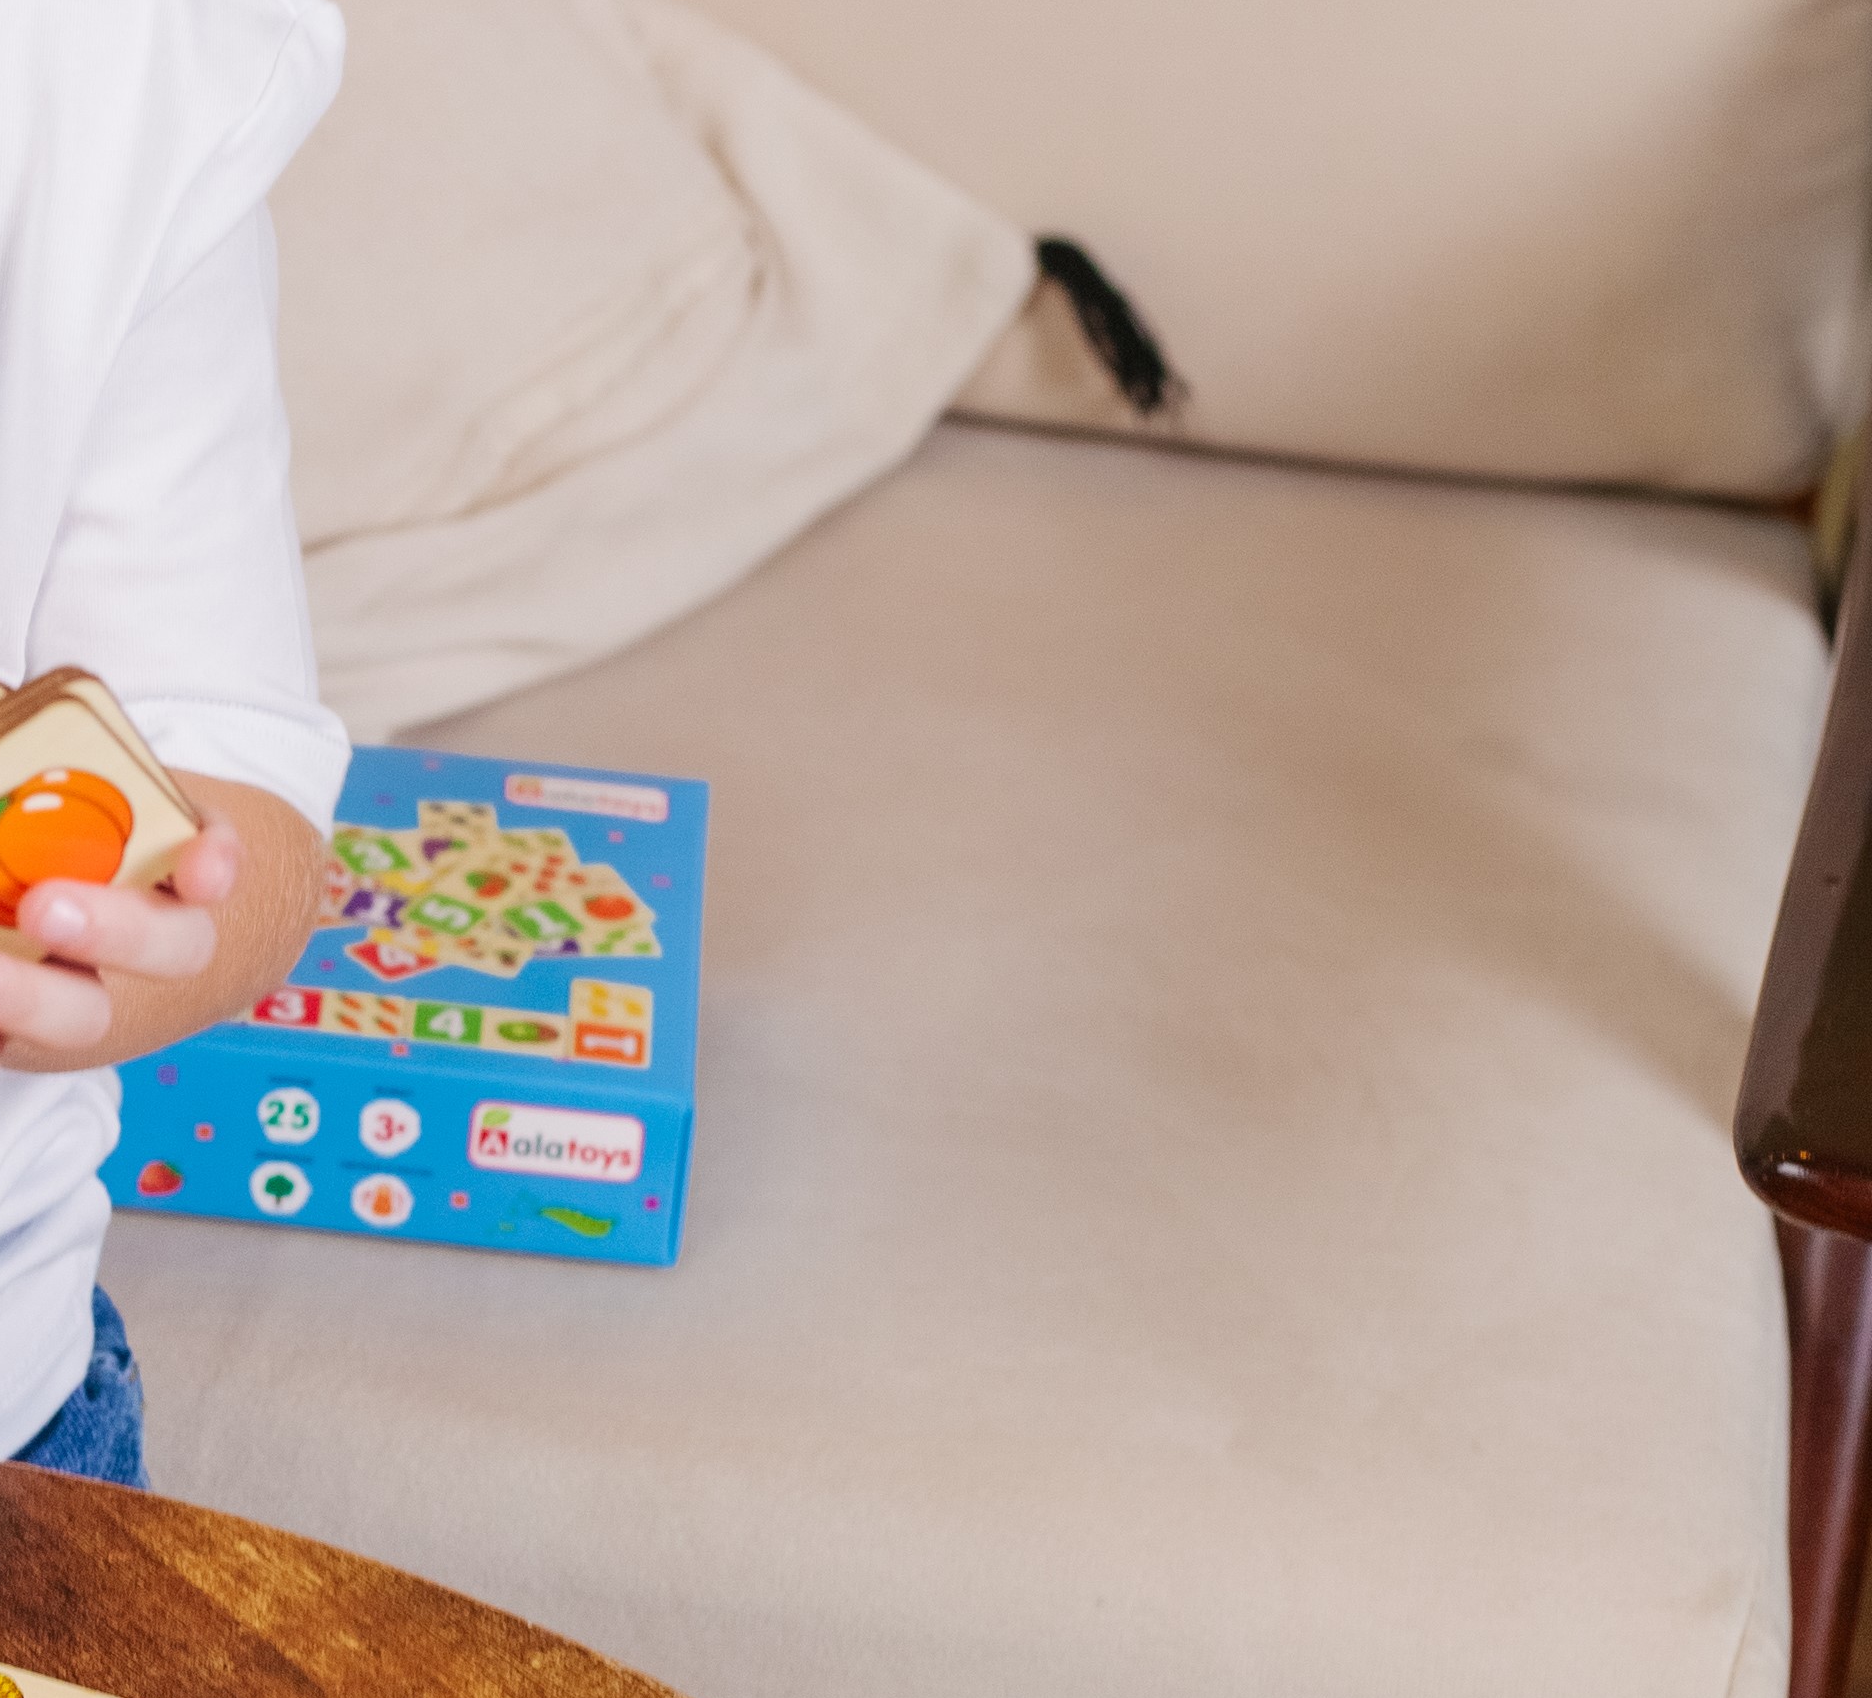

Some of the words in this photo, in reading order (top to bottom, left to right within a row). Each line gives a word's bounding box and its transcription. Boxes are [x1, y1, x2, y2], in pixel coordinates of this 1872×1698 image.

[271, 991, 303, 1021] 3
[430, 1008, 464, 1038] 4
[583, 1033, 636, 1056] 1
[265, 1100, 310, 1129] 25
